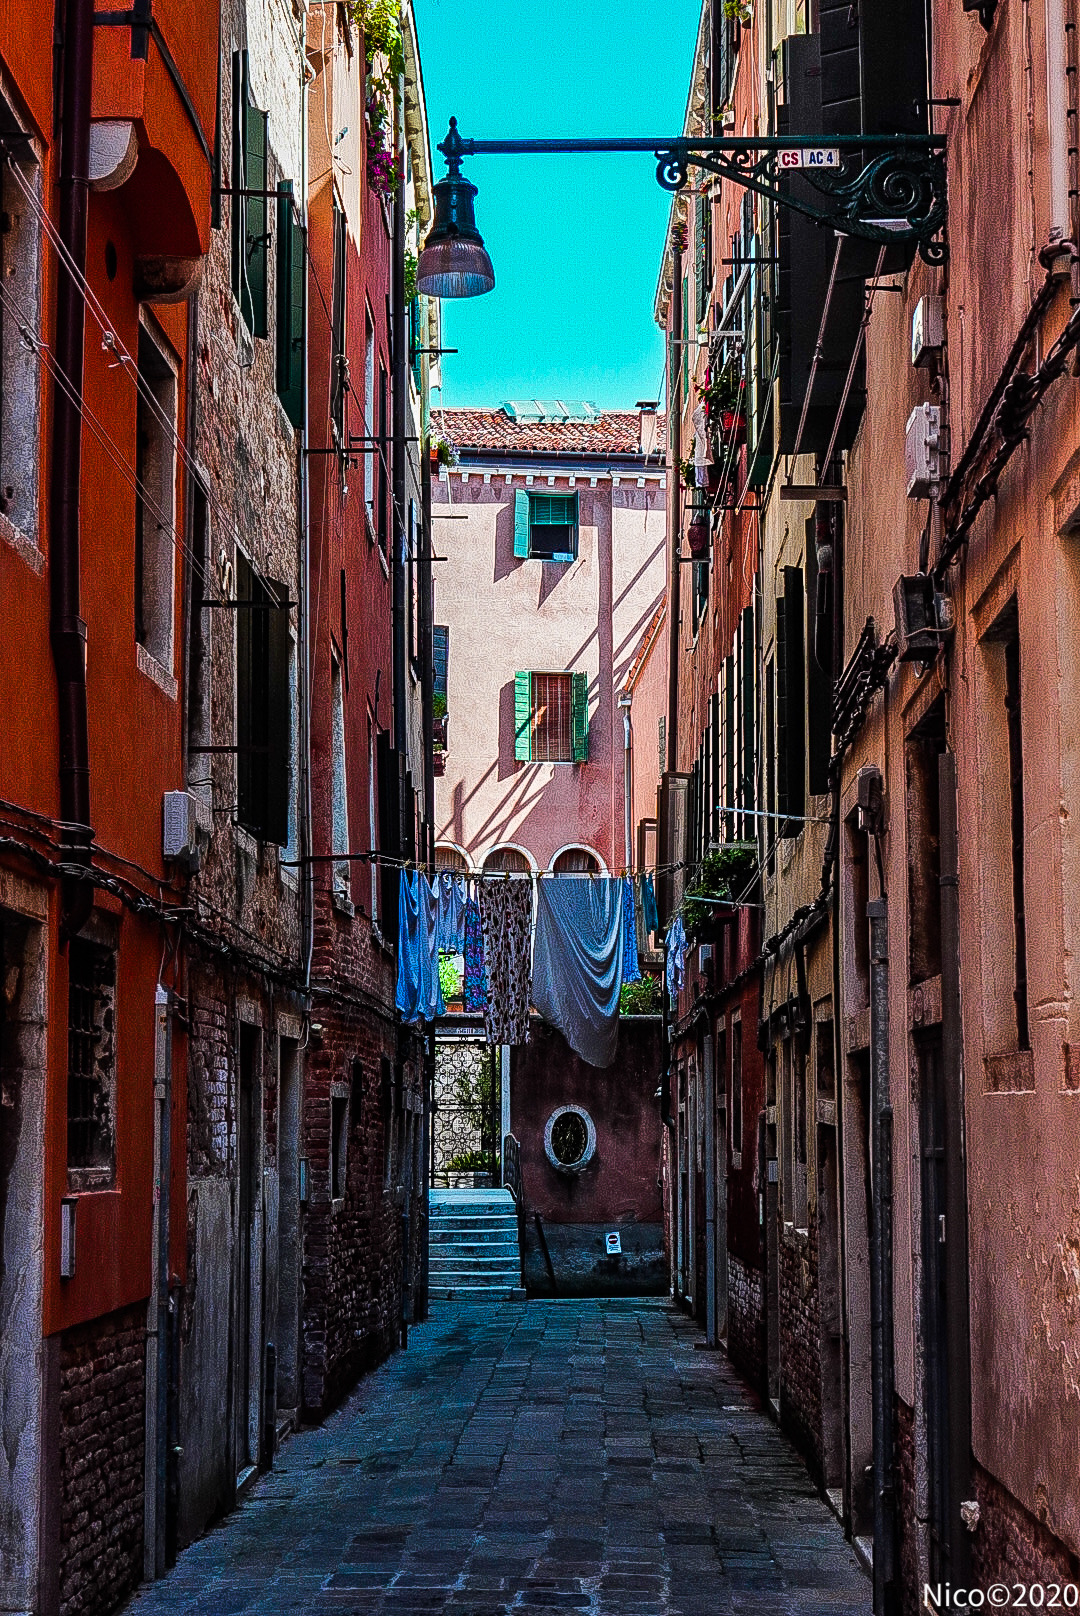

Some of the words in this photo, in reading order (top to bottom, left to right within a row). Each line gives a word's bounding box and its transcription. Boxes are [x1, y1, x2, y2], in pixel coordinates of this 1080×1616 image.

[781, 151, 799, 166] CS
[809, 151, 824, 165] AC
[826, 151, 834, 165] 4
